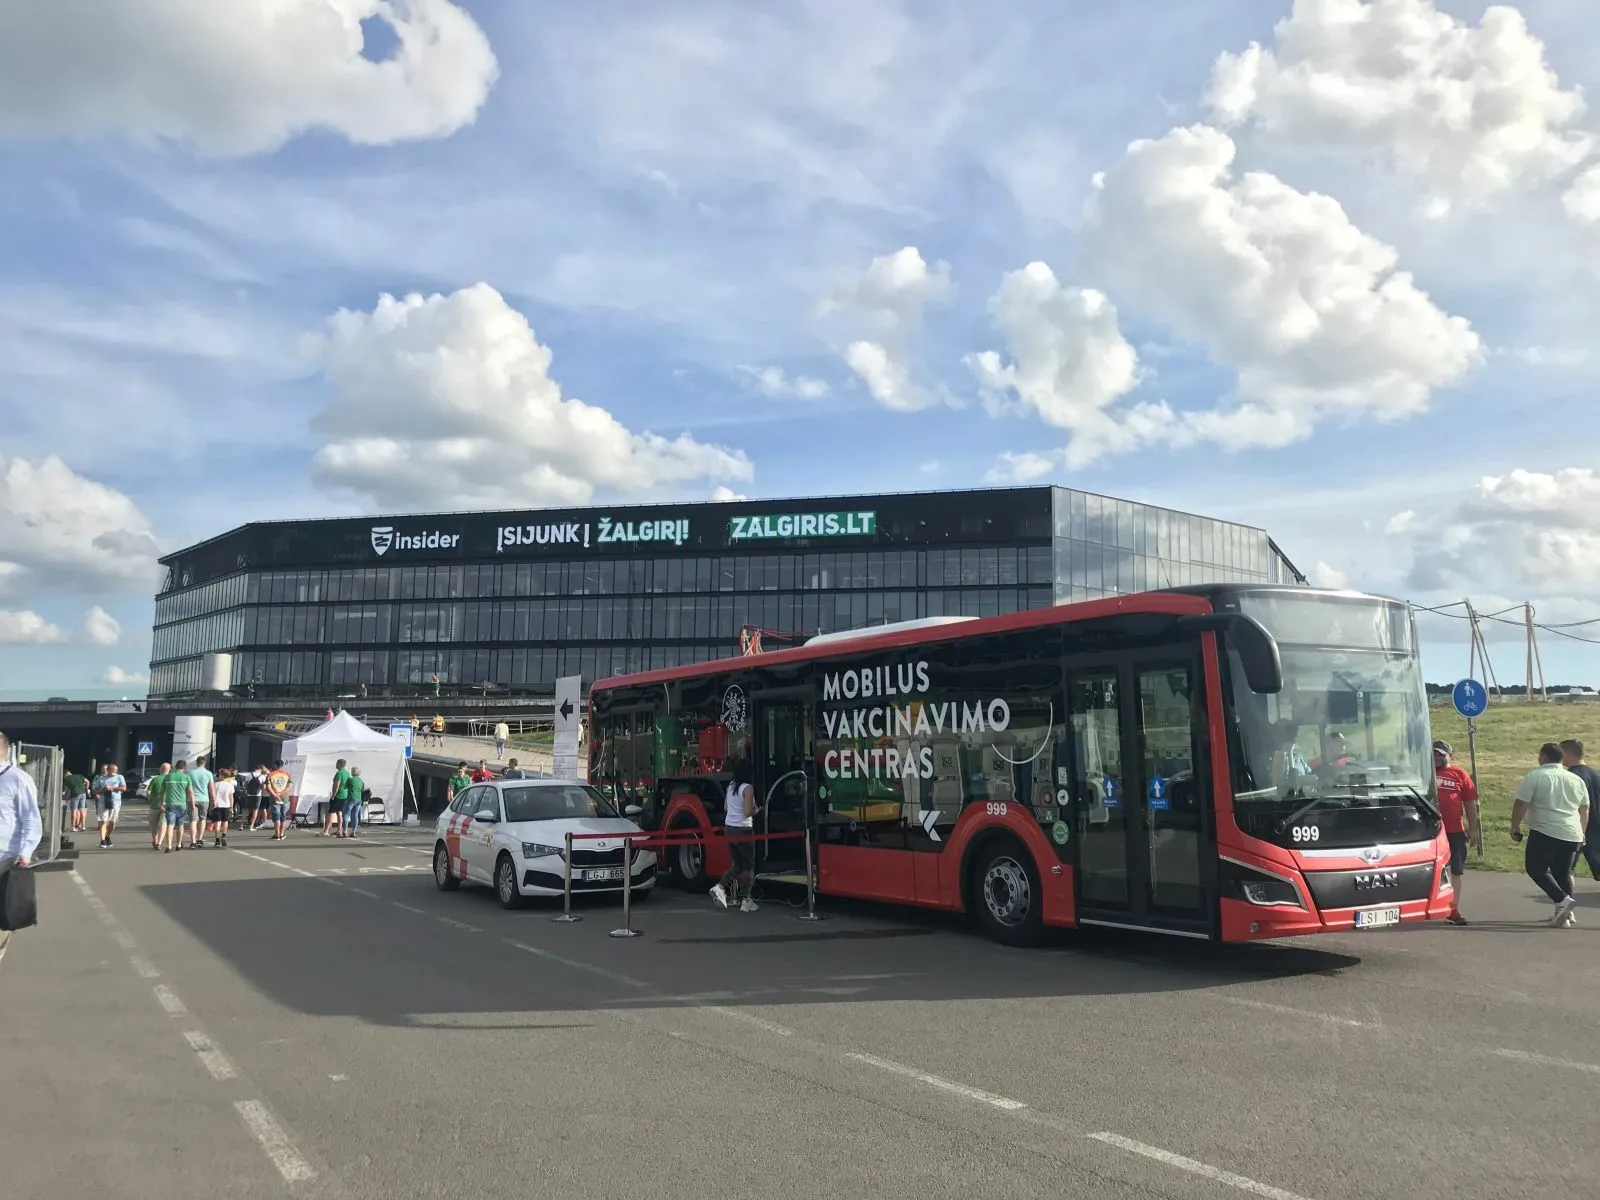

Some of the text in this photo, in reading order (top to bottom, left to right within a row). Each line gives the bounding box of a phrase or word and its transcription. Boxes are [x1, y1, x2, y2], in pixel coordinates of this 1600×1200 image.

[496, 523, 581, 551] ĮSIJUNK
[597, 517, 690, 546] ŽALGIRĮ!
[732, 512, 874, 537] ZALGIRIS.LT
[395, 530, 460, 550] insider
[823, 660, 930, 701] MOBILUS
[823, 698, 1011, 740] VAKCINAVIMO
[824, 747, 934, 780] CENTRAS
[986, 802, 1008, 816] 999
[1292, 825, 1320, 842] 999
[587, 869, 625, 880] LGJ 665
[1355, 872, 1399, 890] MAN
[1360, 909, 1399, 925] LSI 104
